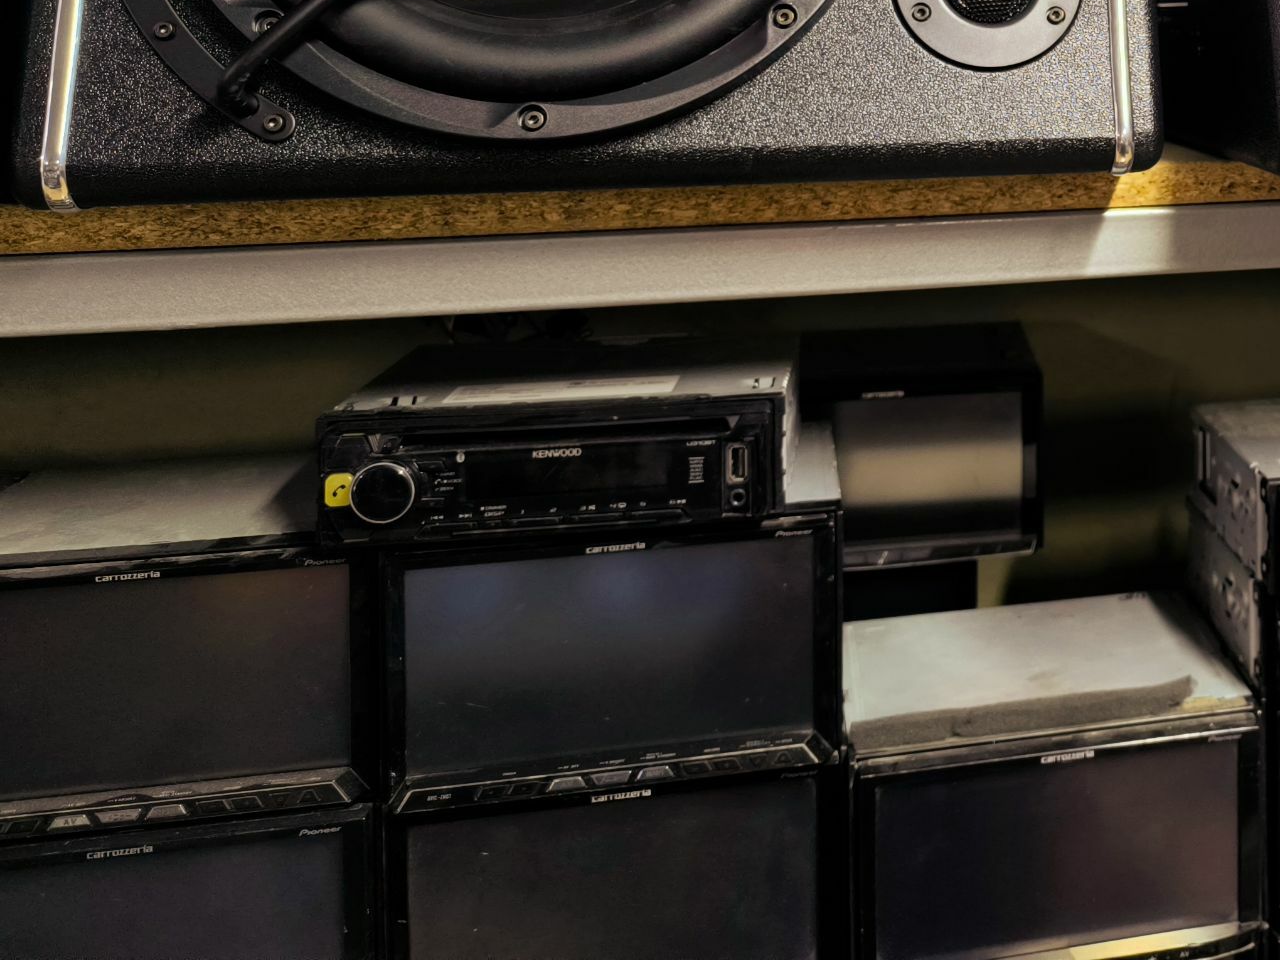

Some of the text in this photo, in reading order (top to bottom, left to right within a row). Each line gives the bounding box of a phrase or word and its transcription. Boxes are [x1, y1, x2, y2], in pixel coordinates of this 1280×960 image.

[531, 447, 584, 460] KENWOOD
[586, 541, 646, 555] carrozzeria
[95, 570, 161, 584] carrozzeria
[299, 826, 342, 837] Pioneer
[86, 844, 154, 860] carrozzeria
